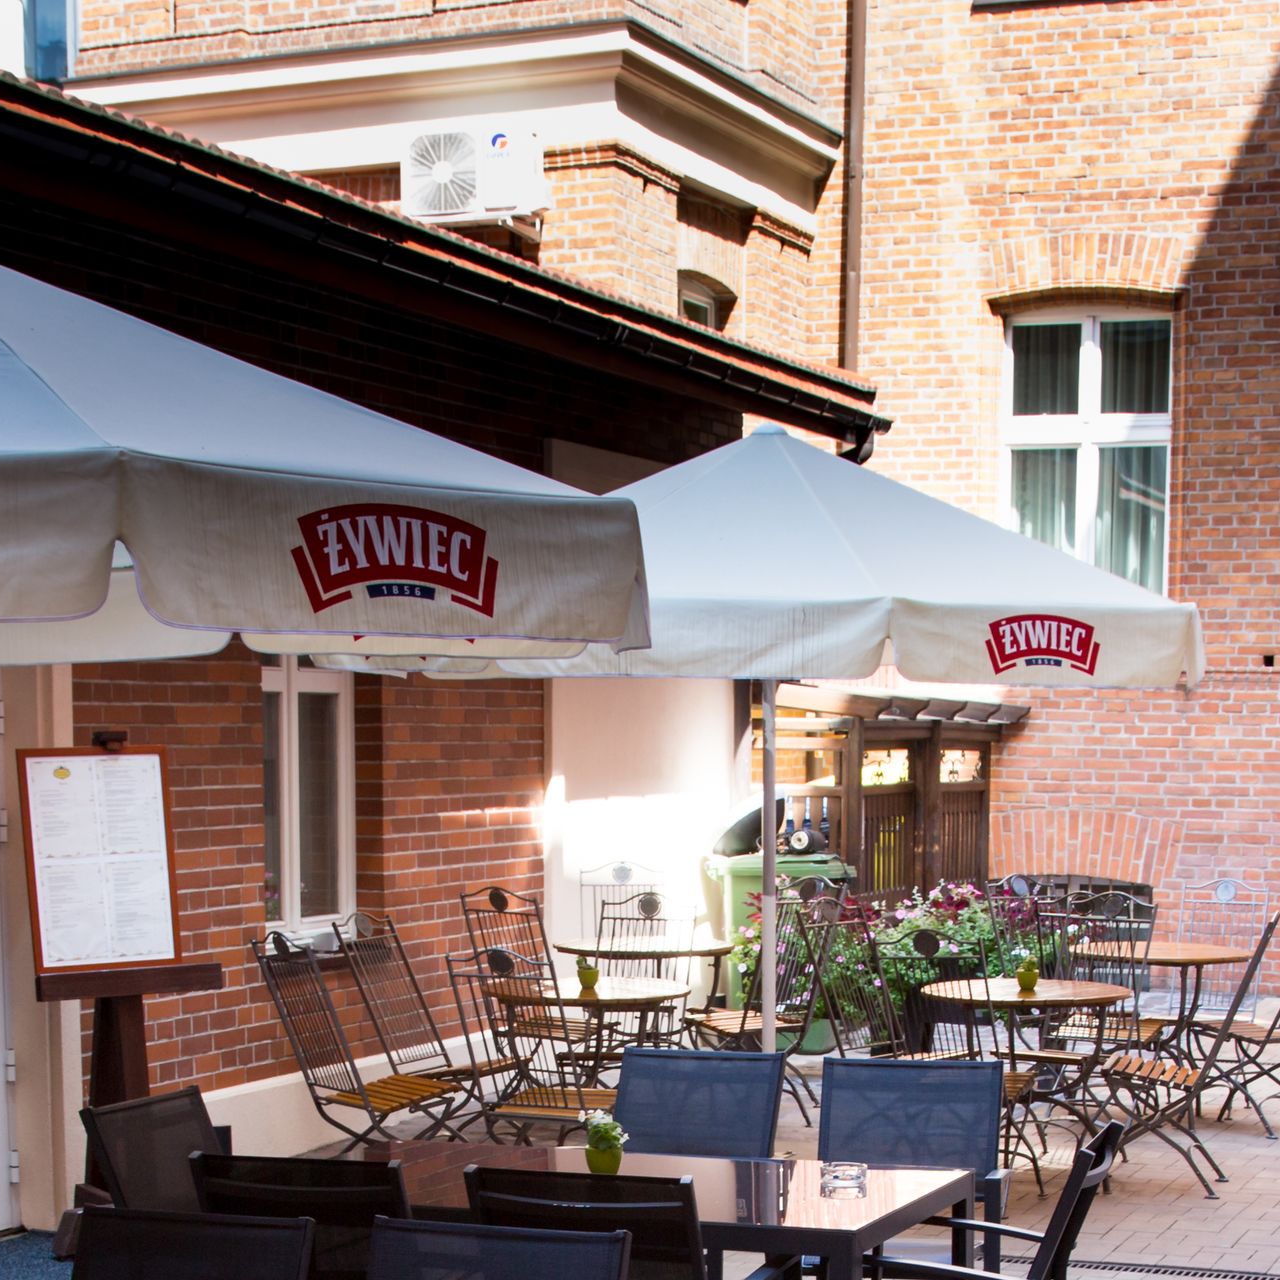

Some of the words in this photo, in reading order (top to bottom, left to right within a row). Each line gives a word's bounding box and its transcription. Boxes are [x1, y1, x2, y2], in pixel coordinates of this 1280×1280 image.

[317, 513, 471, 582] ŻYWIEC
[381, 585, 421, 596] 1856
[999, 620, 1086, 656] ŻYWIEC
